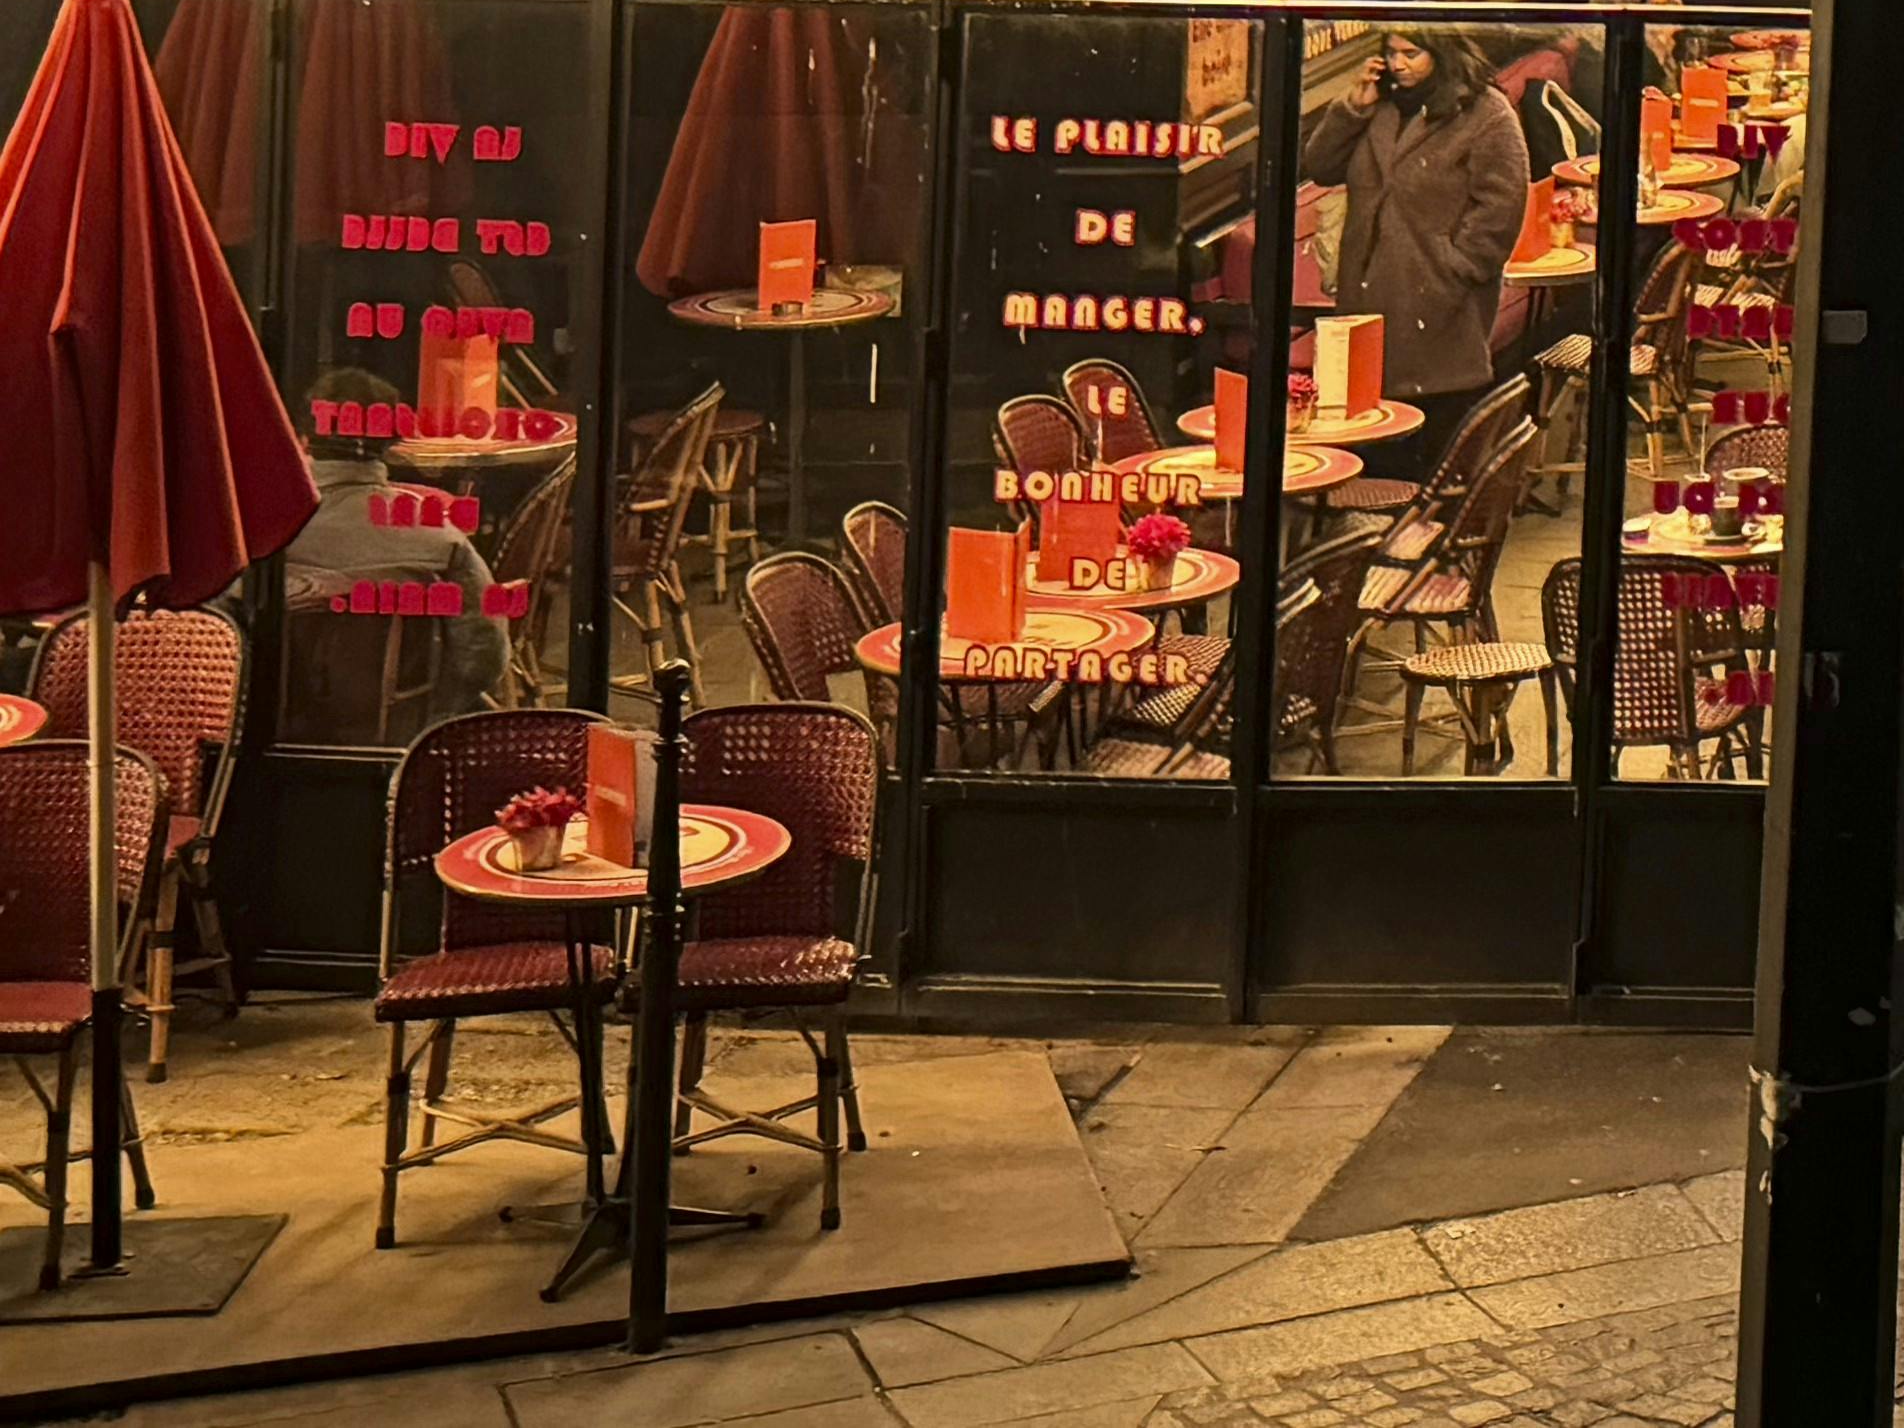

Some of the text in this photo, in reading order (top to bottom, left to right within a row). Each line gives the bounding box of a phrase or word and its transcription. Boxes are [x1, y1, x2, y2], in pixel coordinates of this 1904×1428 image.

[990, 116, 1225, 159] LE PLAISIR
[1074, 210, 1136, 245] DE
[1086, 386, 1128, 417] LE
[994, 471, 1202, 506] BONHEUR
[1071, 559, 1126, 590] DE
